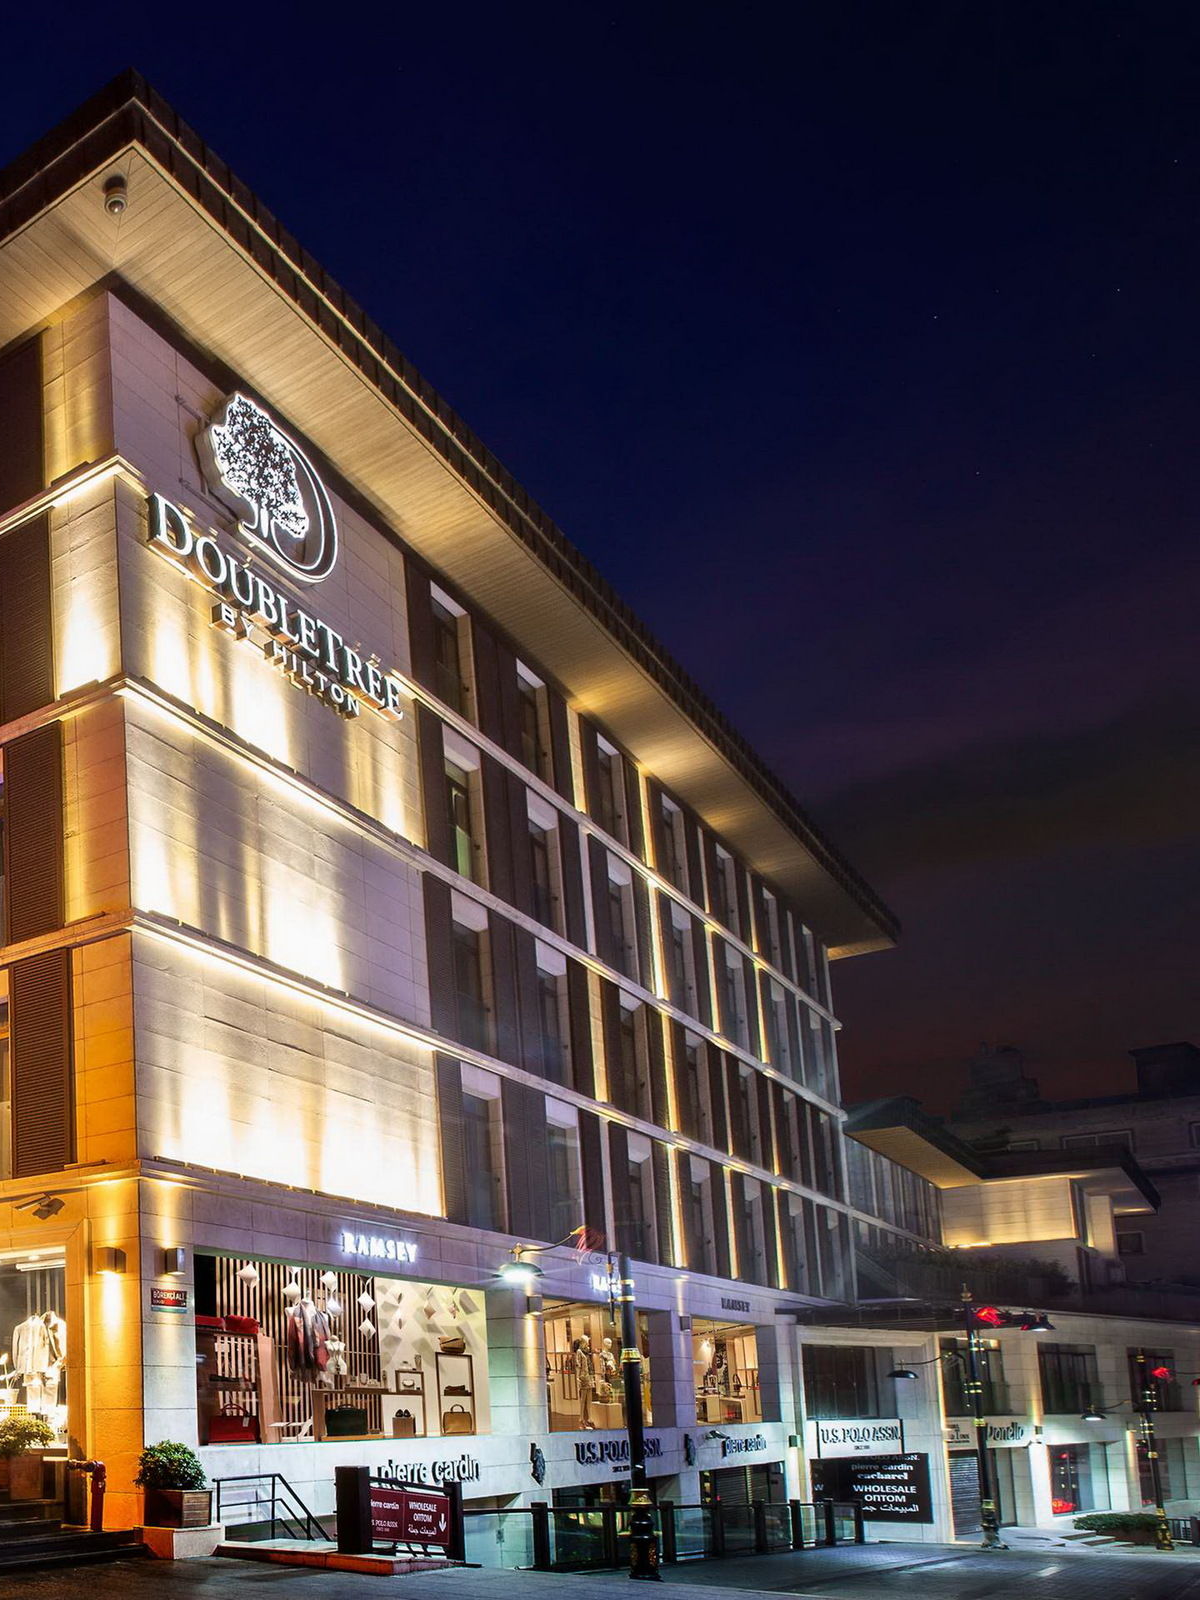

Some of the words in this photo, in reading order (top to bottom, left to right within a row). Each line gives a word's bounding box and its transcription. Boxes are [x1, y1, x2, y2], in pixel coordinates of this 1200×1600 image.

[216, 601, 255, 641] BY
[272, 639, 360, 717] HILTON
[342, 1231, 418, 1263] RAMSEY
[821, 1429, 842, 1443] U.S.
[842, 1428, 871, 1443] POLO
[430, 1454, 480, 1485] cardin
[882, 1463, 913, 1471] cardin
[857, 1472, 908, 1480] cacharel
[853, 1484, 916, 1493] WHOLESALE
[408, 1501, 437, 1512] WHOLESALE
